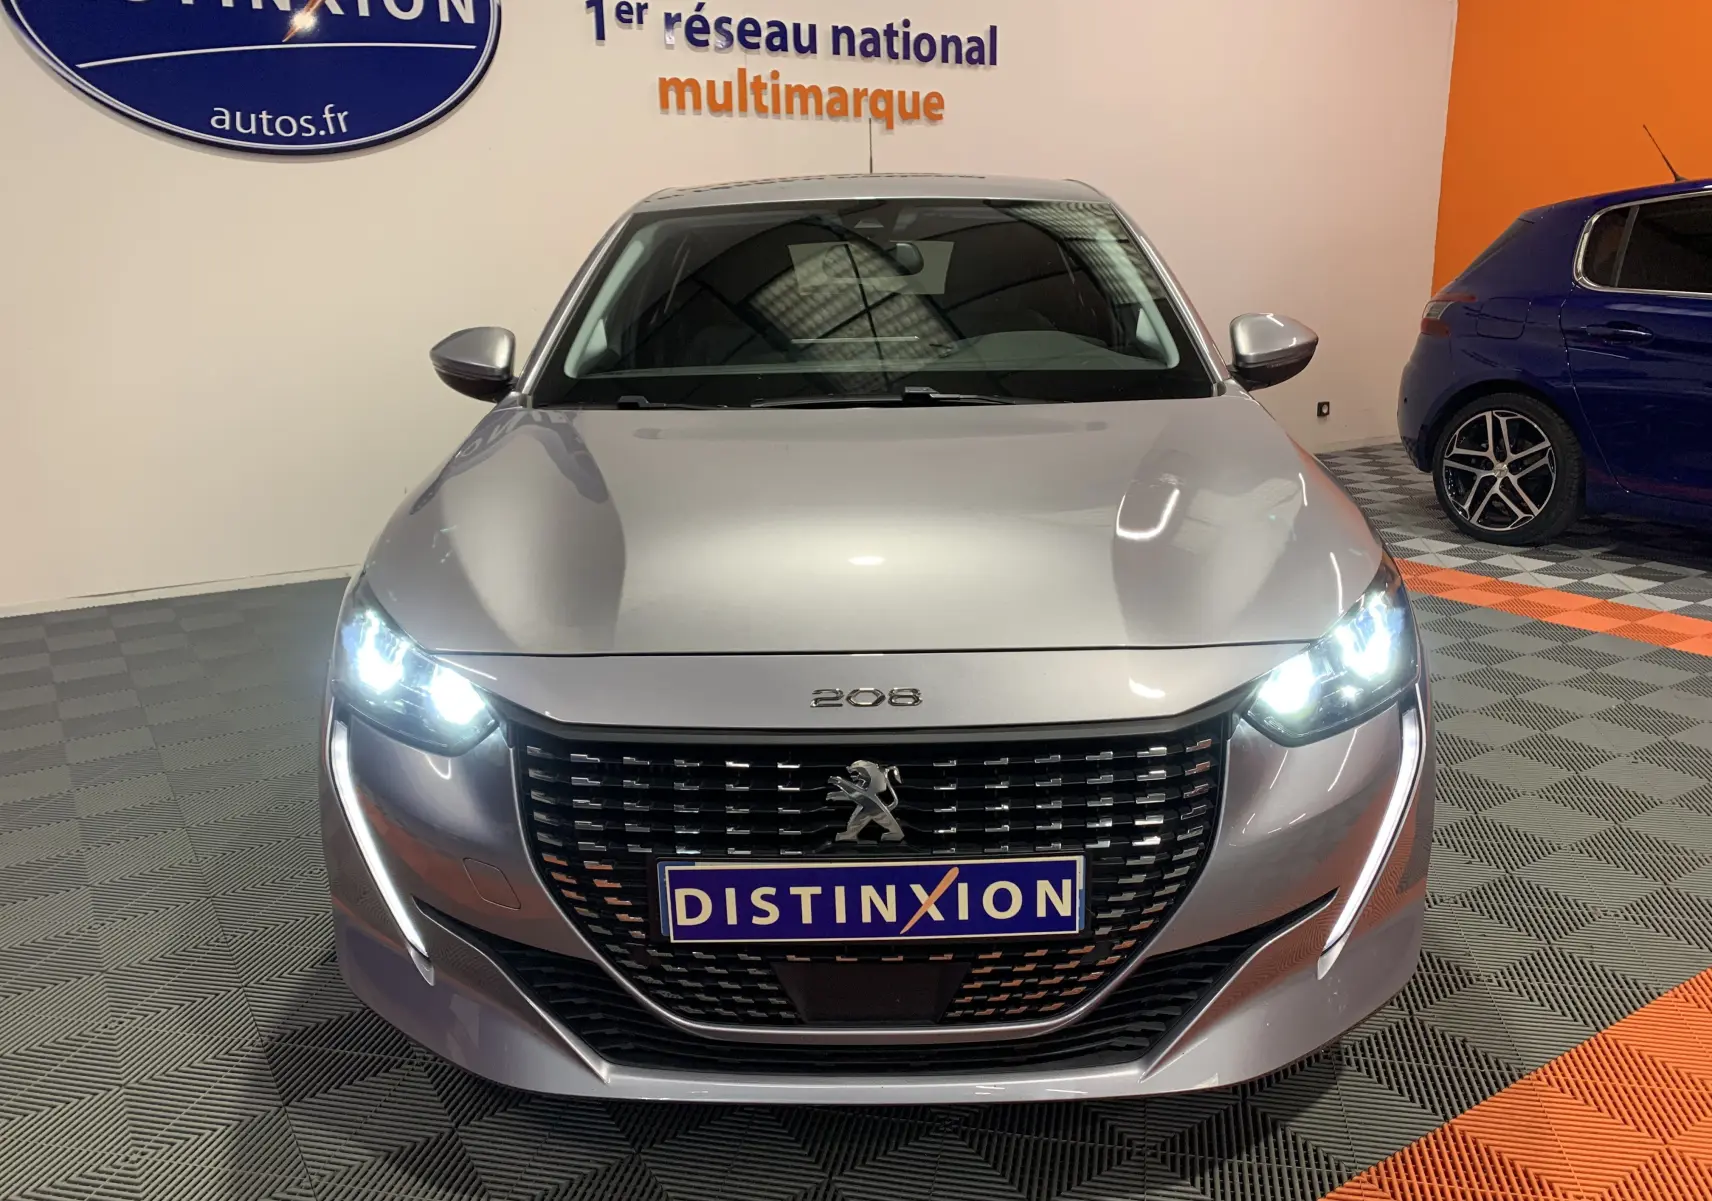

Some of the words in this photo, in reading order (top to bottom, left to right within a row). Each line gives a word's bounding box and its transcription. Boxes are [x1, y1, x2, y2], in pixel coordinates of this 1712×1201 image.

[663, 2, 817, 54] réseau
[832, 18, 998, 66] national
[210, 103, 349, 137] autos.fr
[658, 67, 945, 130] multimarque
[810, 687, 923, 708] 208
[674, 866, 1072, 935] DISTINXION
